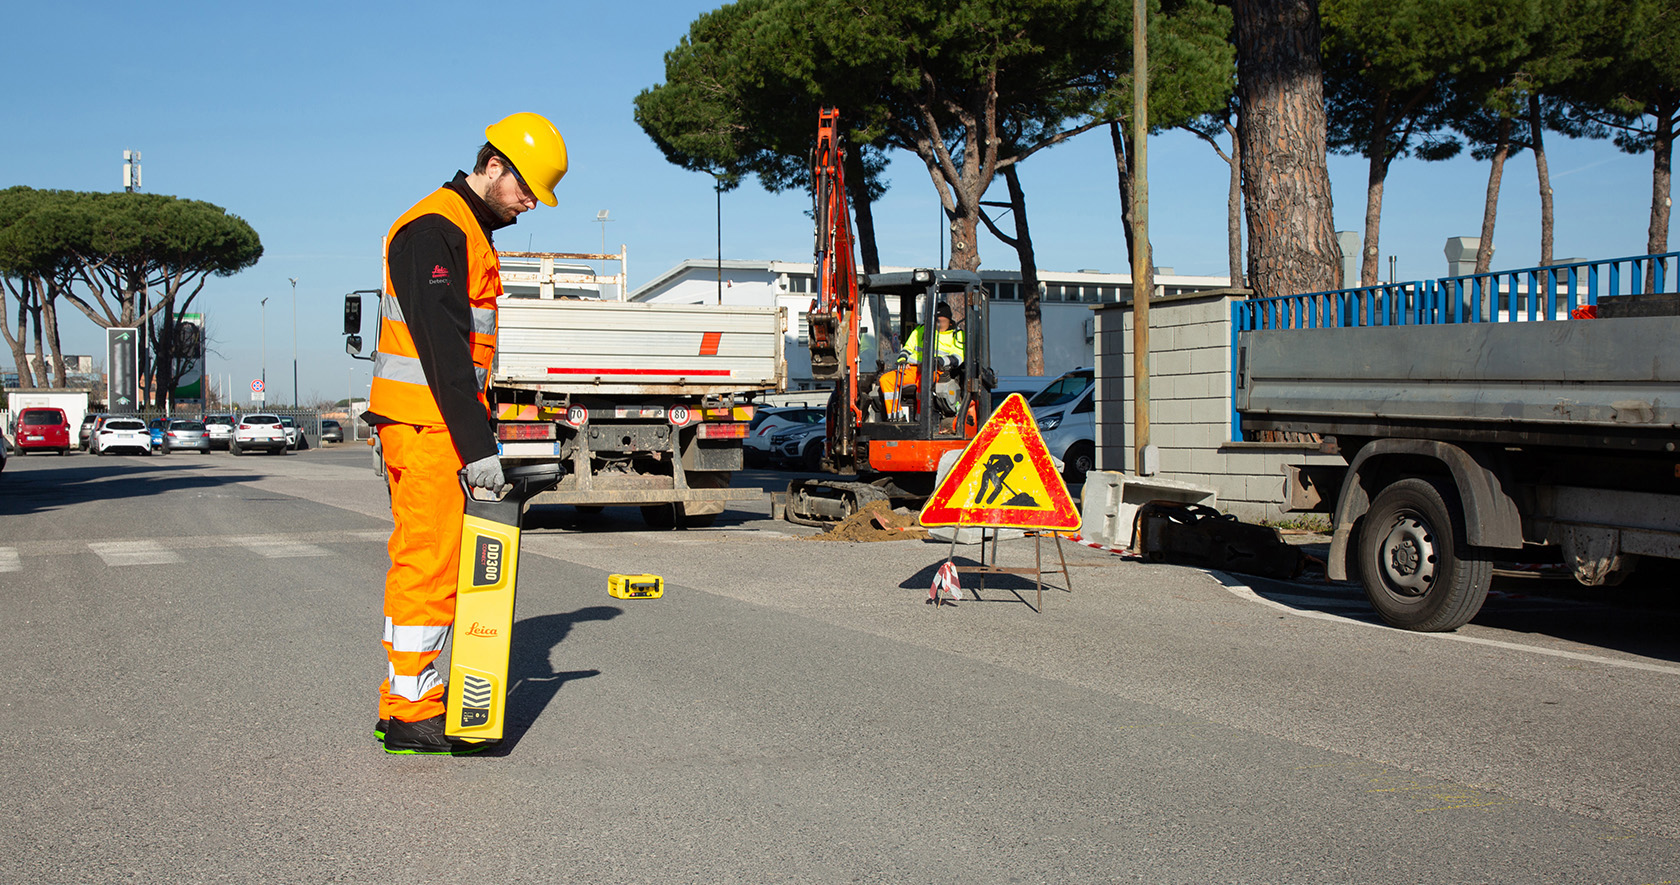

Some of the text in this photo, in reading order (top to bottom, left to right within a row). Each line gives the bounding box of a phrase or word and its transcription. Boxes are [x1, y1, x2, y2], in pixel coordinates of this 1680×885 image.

[570, 409, 582, 419] 70
[674, 409, 686, 419] 80
[485, 543, 500, 581] DD300
[464, 621, 499, 638] Leica
